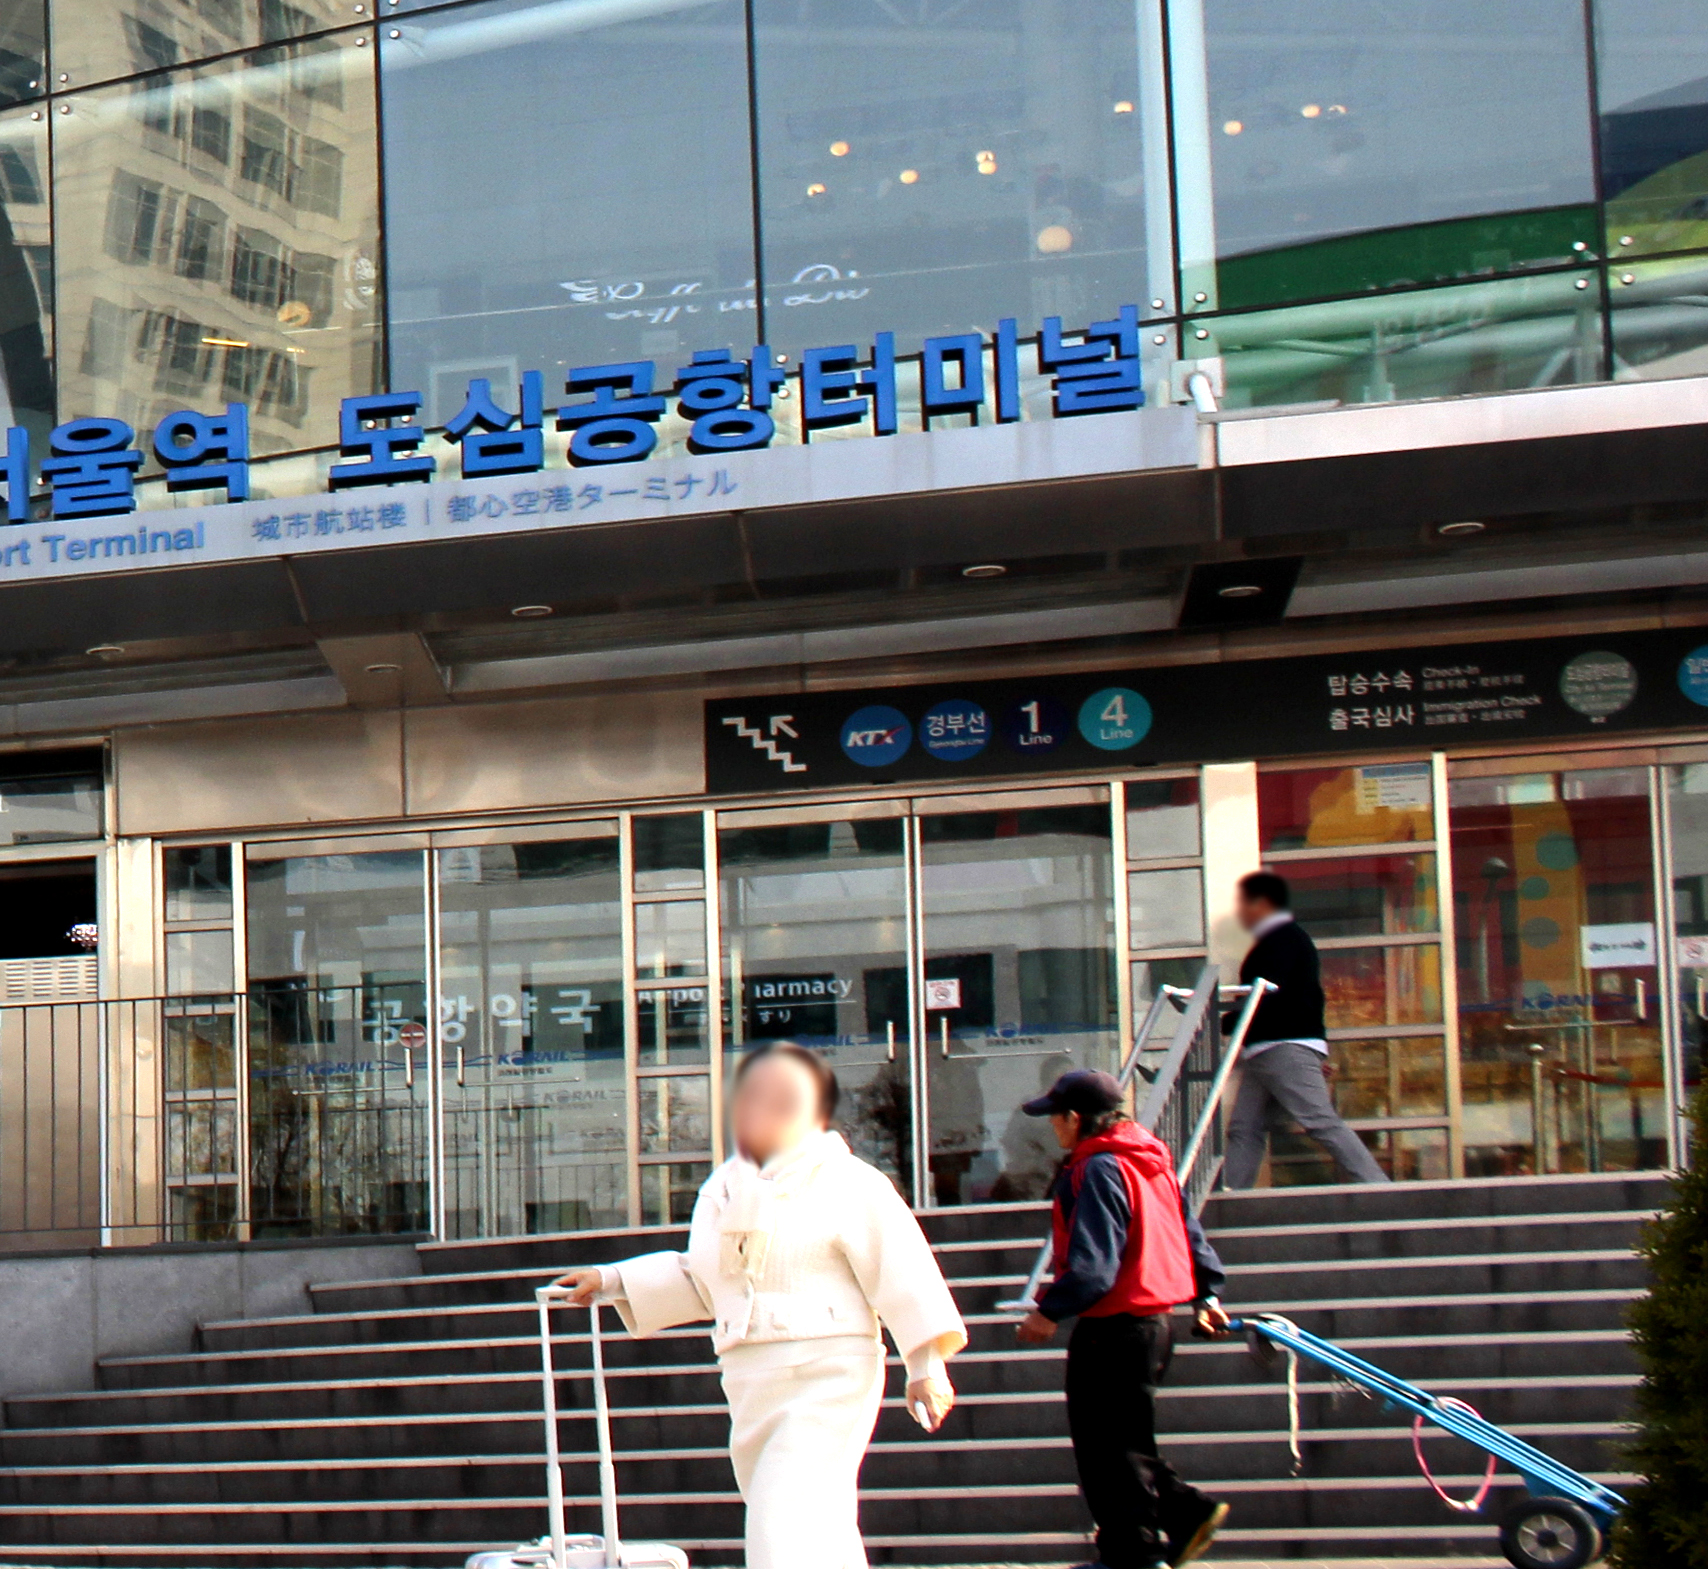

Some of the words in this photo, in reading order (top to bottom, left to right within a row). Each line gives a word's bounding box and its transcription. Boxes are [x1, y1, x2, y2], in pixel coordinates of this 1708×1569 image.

[330, 305, 1145, 488] 도심공항터미널
[447, 470, 738, 523] 都心空港ターミナル
[252, 501, 407, 542] 城市航站楼
[40, 521, 205, 564] Terminal
[1328, 669, 1414, 697] 탑승수속
[1100, 694, 1129, 726] 4
[1501, 694, 1544, 707] Check
[927, 711, 986, 737] 경부선
[1021, 700, 1040, 733] 1
[1329, 704, 1416, 731] 출국심사
[846, 726, 904, 747] KTX
[1019, 733, 1052, 746] Line
[1100, 727, 1133, 740] Line
[497, 1049, 570, 1066] KORAIL
